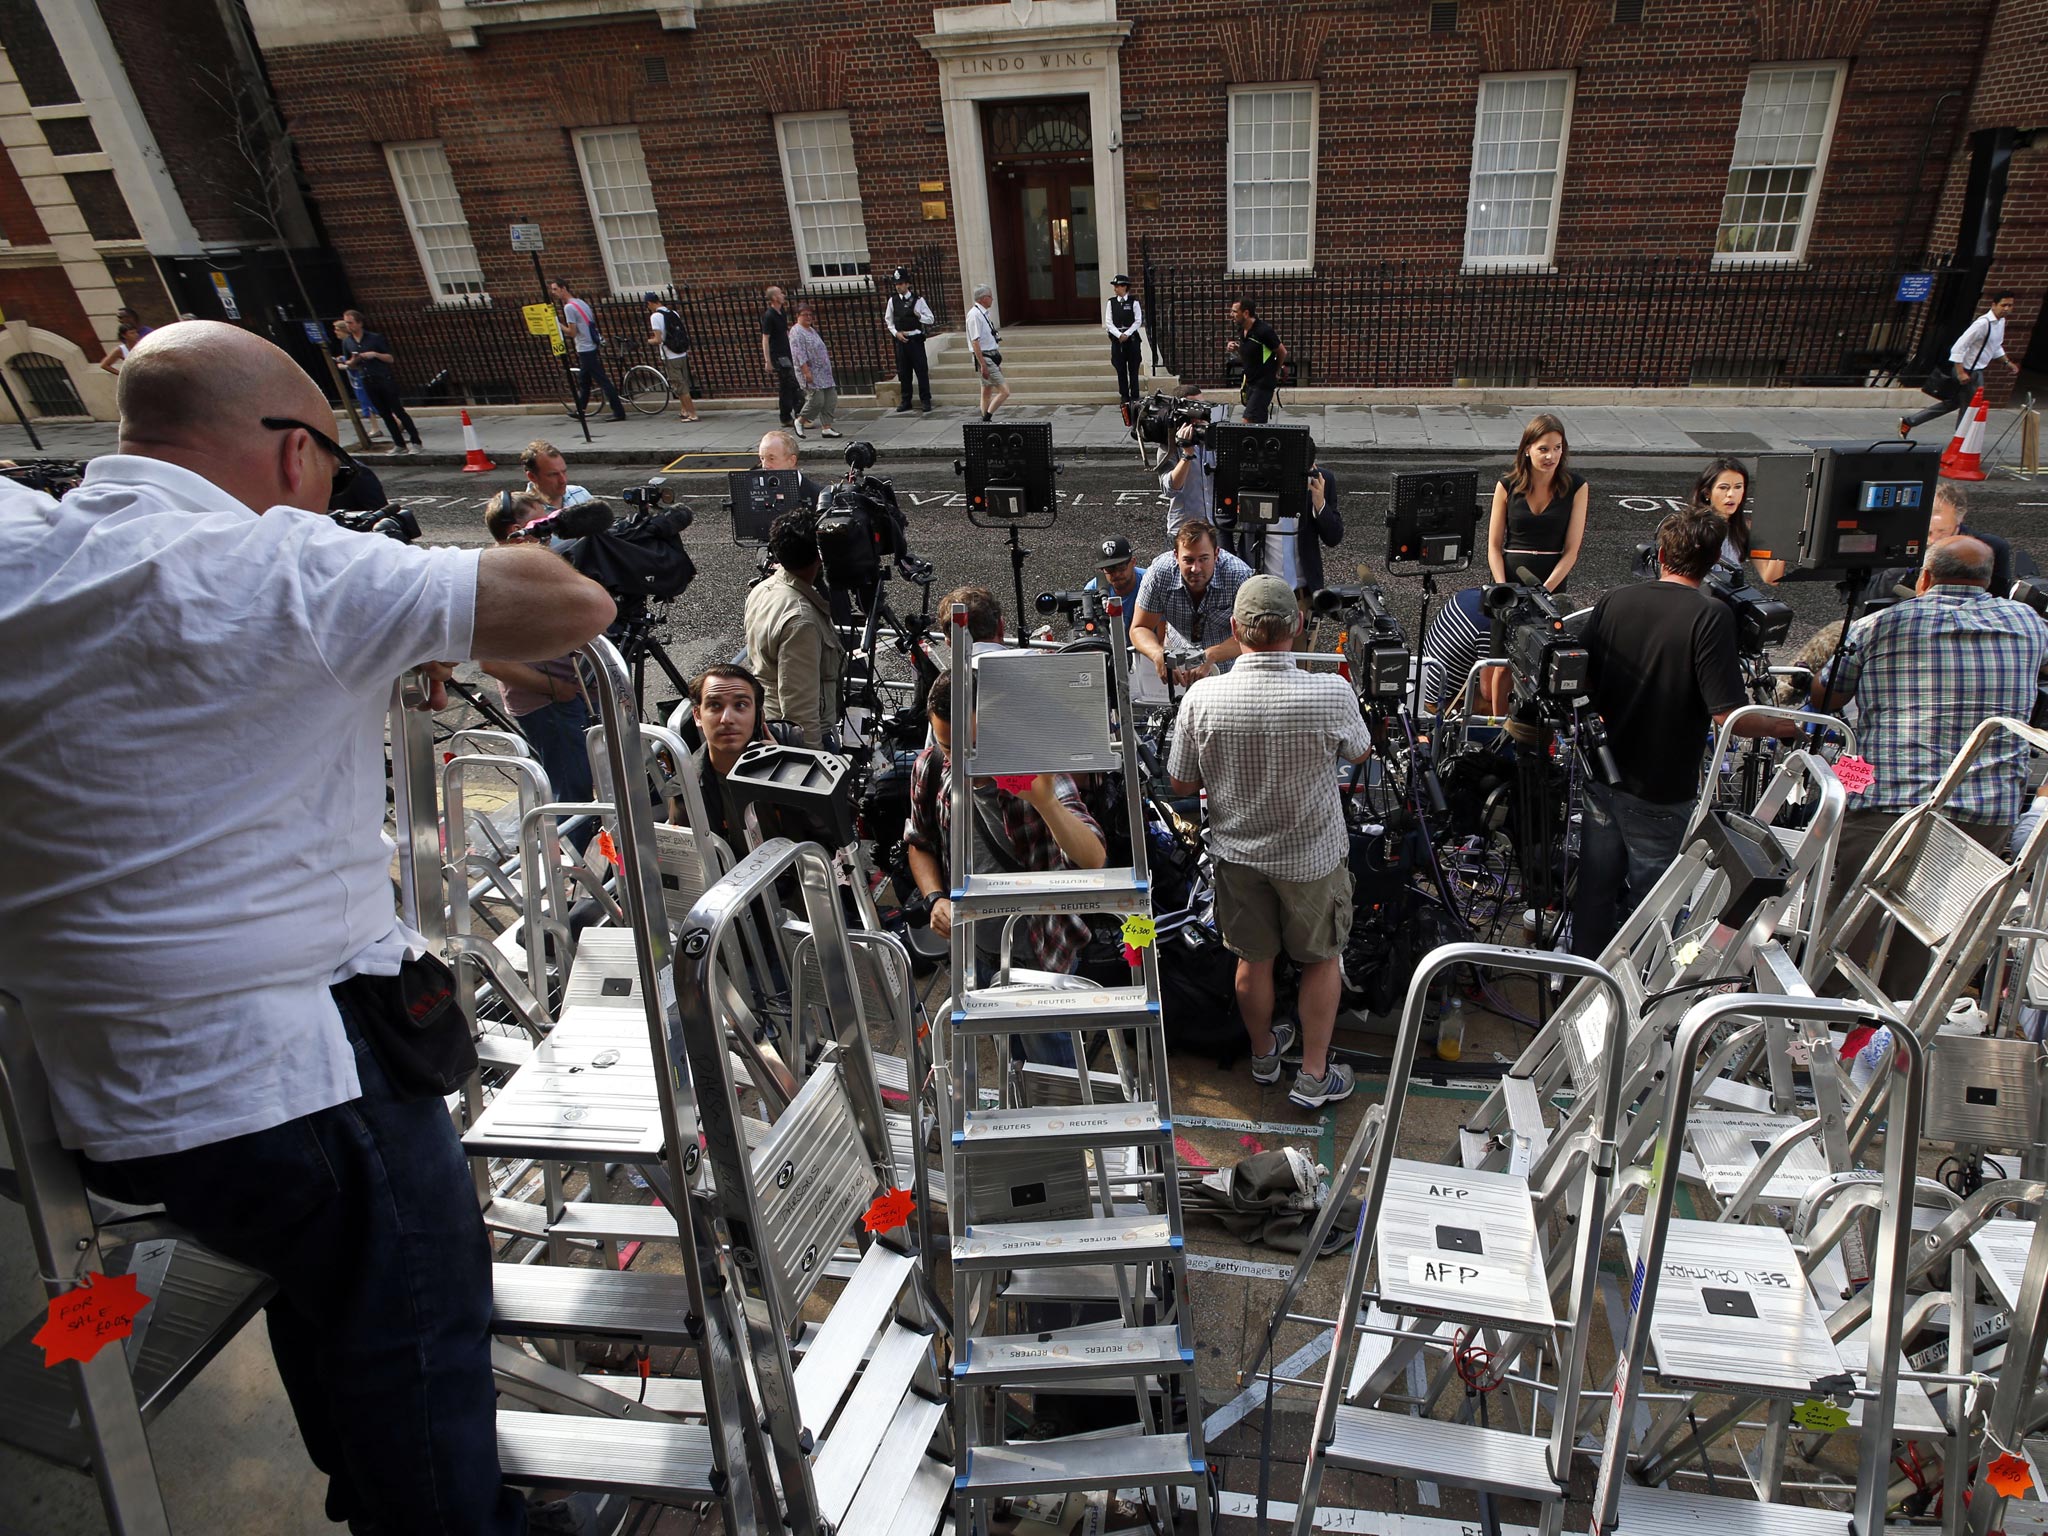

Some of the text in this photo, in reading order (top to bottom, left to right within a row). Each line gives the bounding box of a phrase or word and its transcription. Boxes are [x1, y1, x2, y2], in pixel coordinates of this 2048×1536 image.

[962, 52, 1092, 74] LINDO WING
[553, 343, 565, 355] NO
[1840, 760, 1870, 775] JACOBS
[1049, 878, 1089, 886] REUTERS
[1060, 902, 1101, 911] REUTERS
[966, 1001, 999, 1009] EUTERS
[1037, 997, 1077, 1005] REUTERS
[992, 1122, 1031, 1131] REUTERS
[1069, 1119, 1108, 1127] REUTERS
[1429, 1184, 1469, 1200] AFP
[1002, 1240, 1041, 1249] REUTERS
[1215, 1261, 1274, 1276] gettyimages
[1425, 1262, 1479, 1284] AFP
[1744, 1271, 1791, 1289] BEN
[60, 1296, 93, 1320] FOR
[67, 1306, 112, 1332] SALE
[1010, 1345, 1123, 1358] REUTERS REUTERS
[1323, 1509, 1357, 1530] AFP
